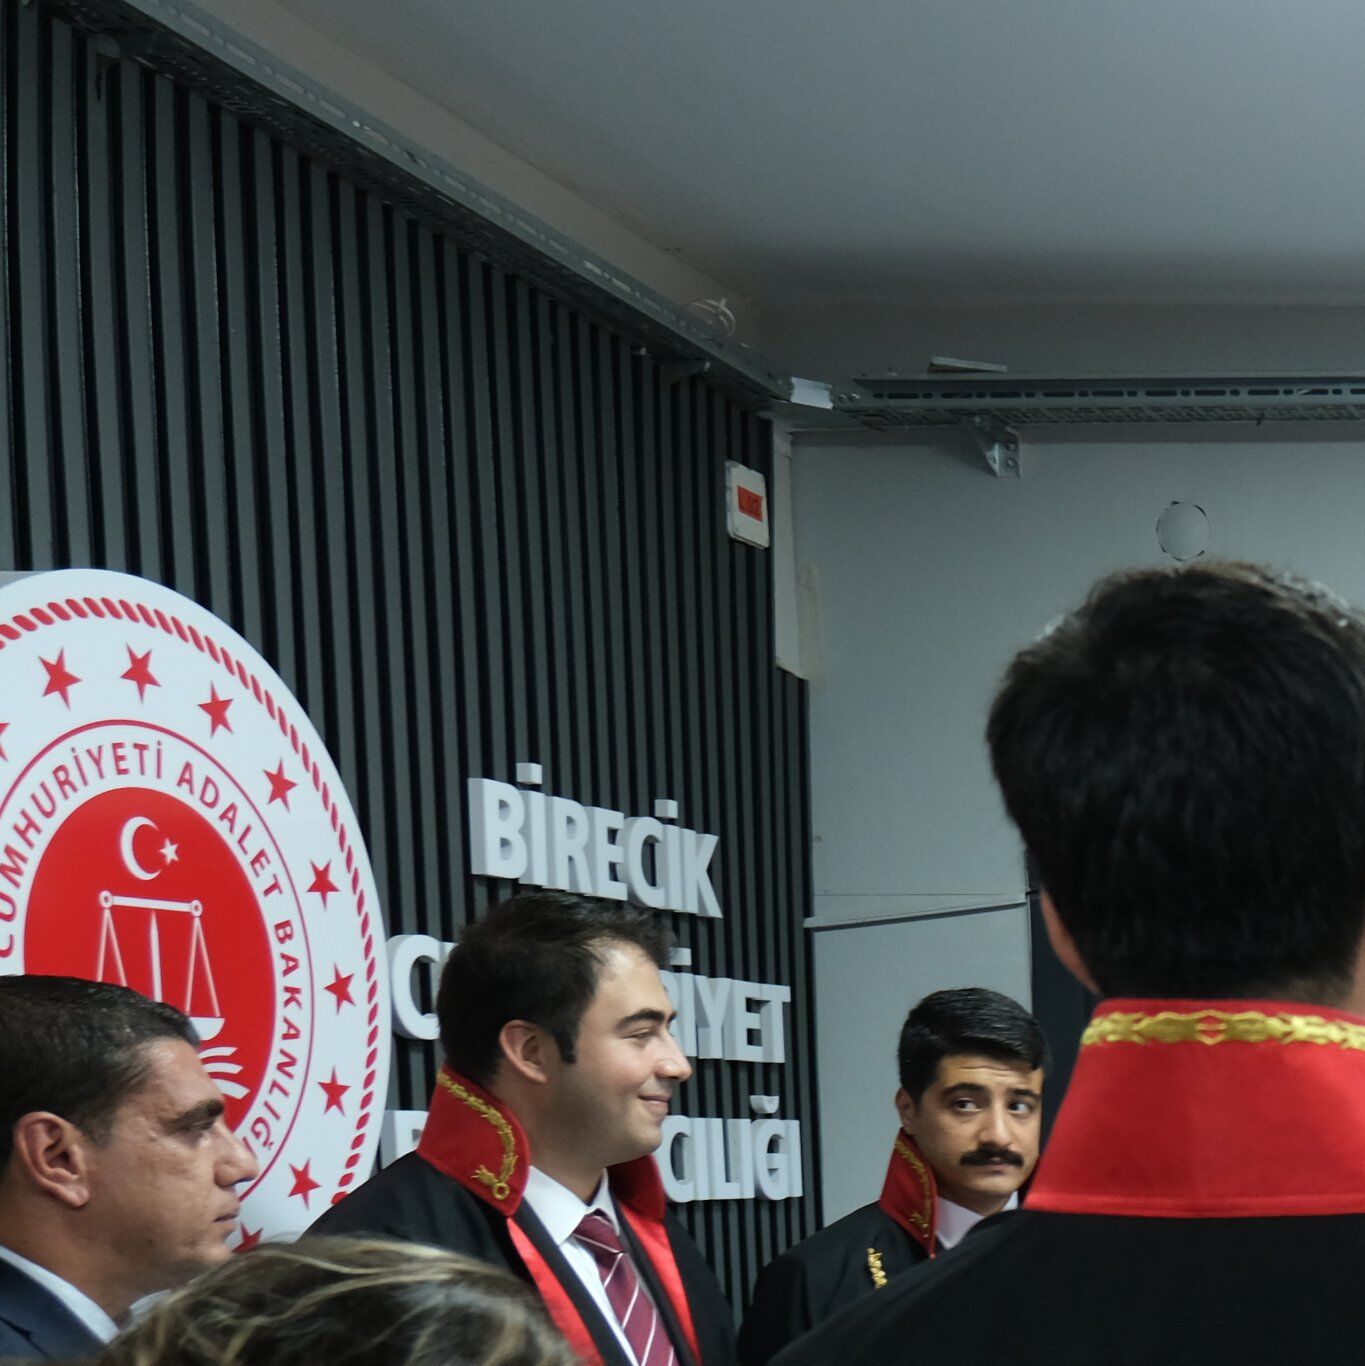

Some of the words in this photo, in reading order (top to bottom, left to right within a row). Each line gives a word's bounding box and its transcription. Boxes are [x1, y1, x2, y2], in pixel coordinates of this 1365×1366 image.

[177, 761, 283, 898] ADALET
[243, 919, 302, 1159] BAKANLIĞI
[468, 762, 723, 918] BİRECİK
